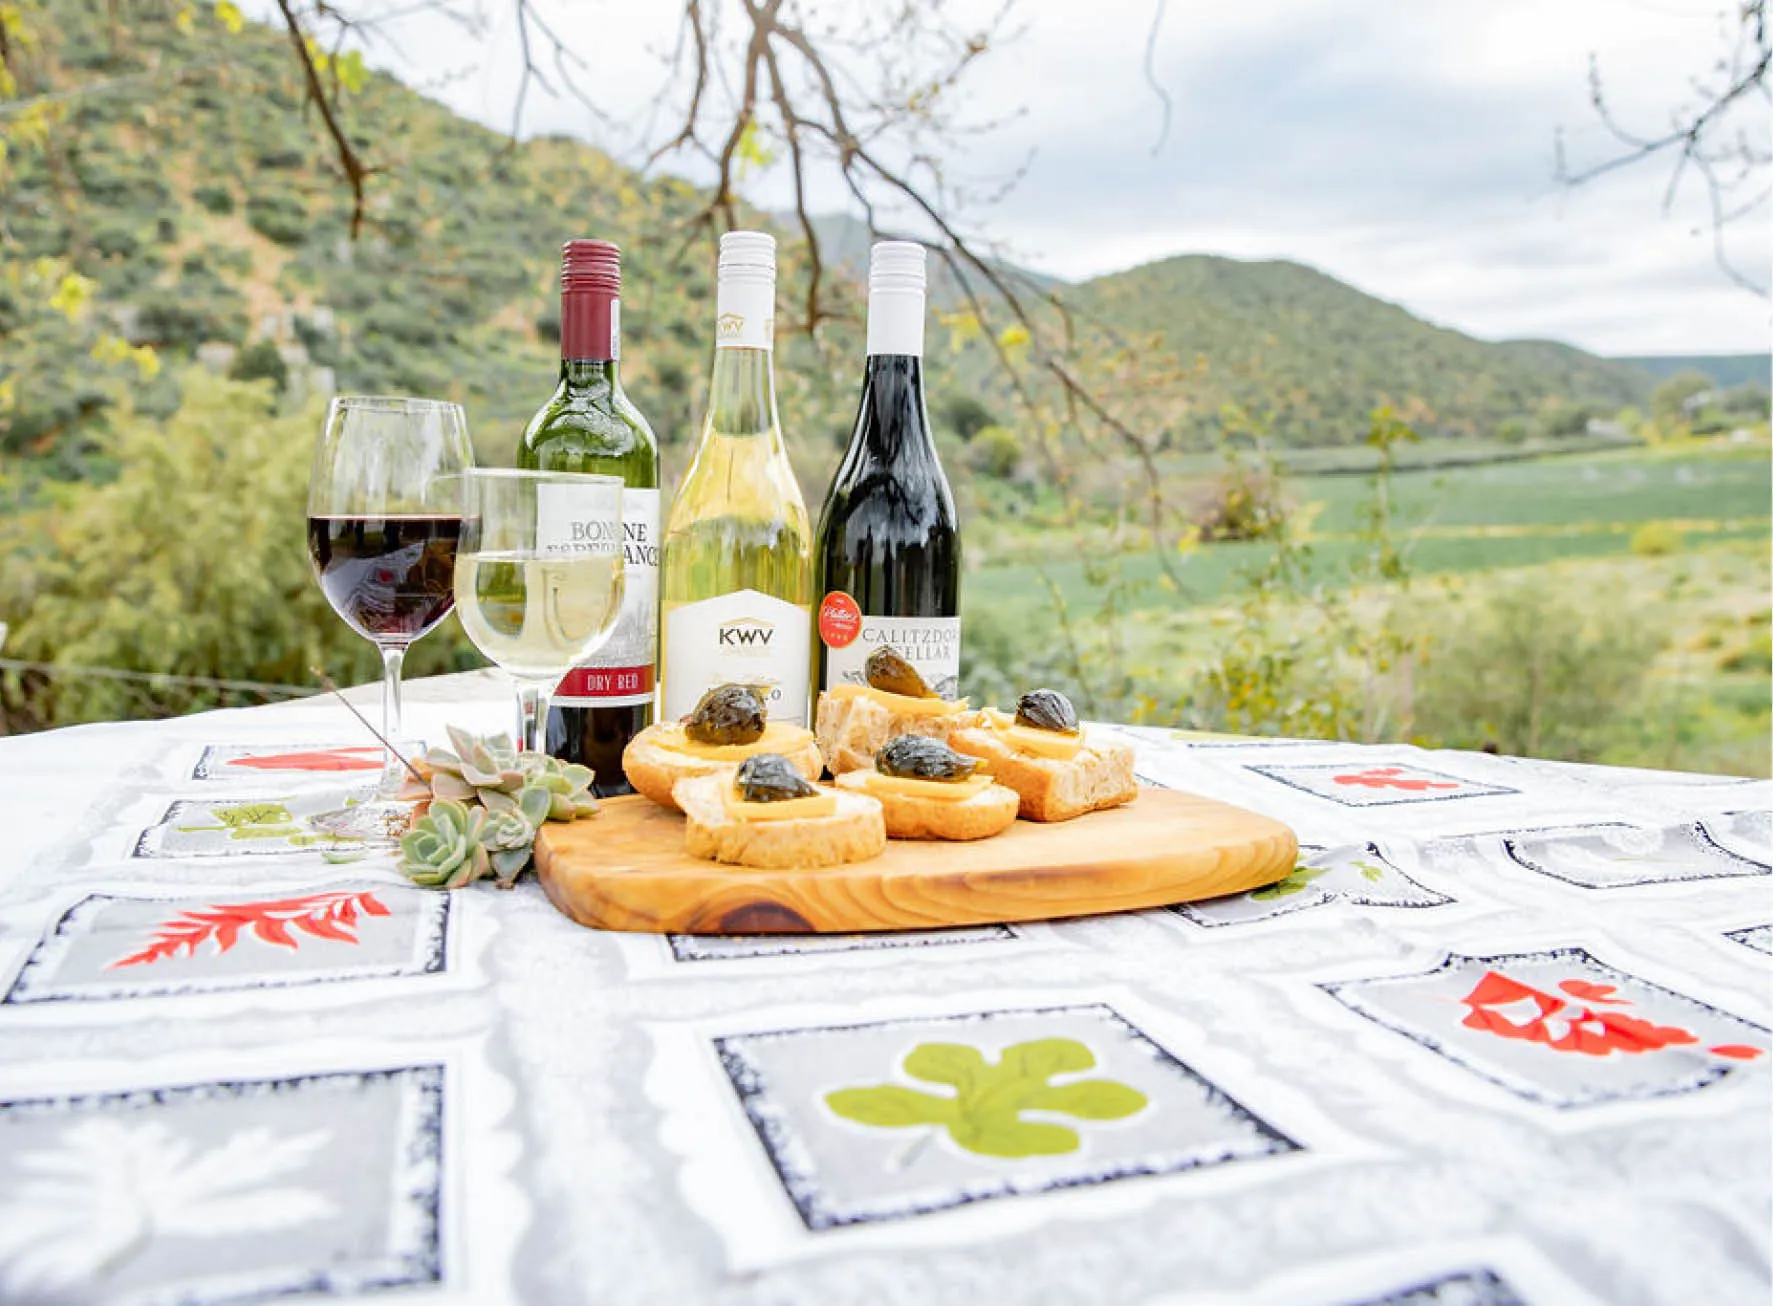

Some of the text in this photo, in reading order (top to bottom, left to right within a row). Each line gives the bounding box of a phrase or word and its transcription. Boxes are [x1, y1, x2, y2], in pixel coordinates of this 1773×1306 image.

[571, 520, 647, 541] BONNE
[719, 628, 774, 645] KWV
[588, 674, 611, 690] DRY
